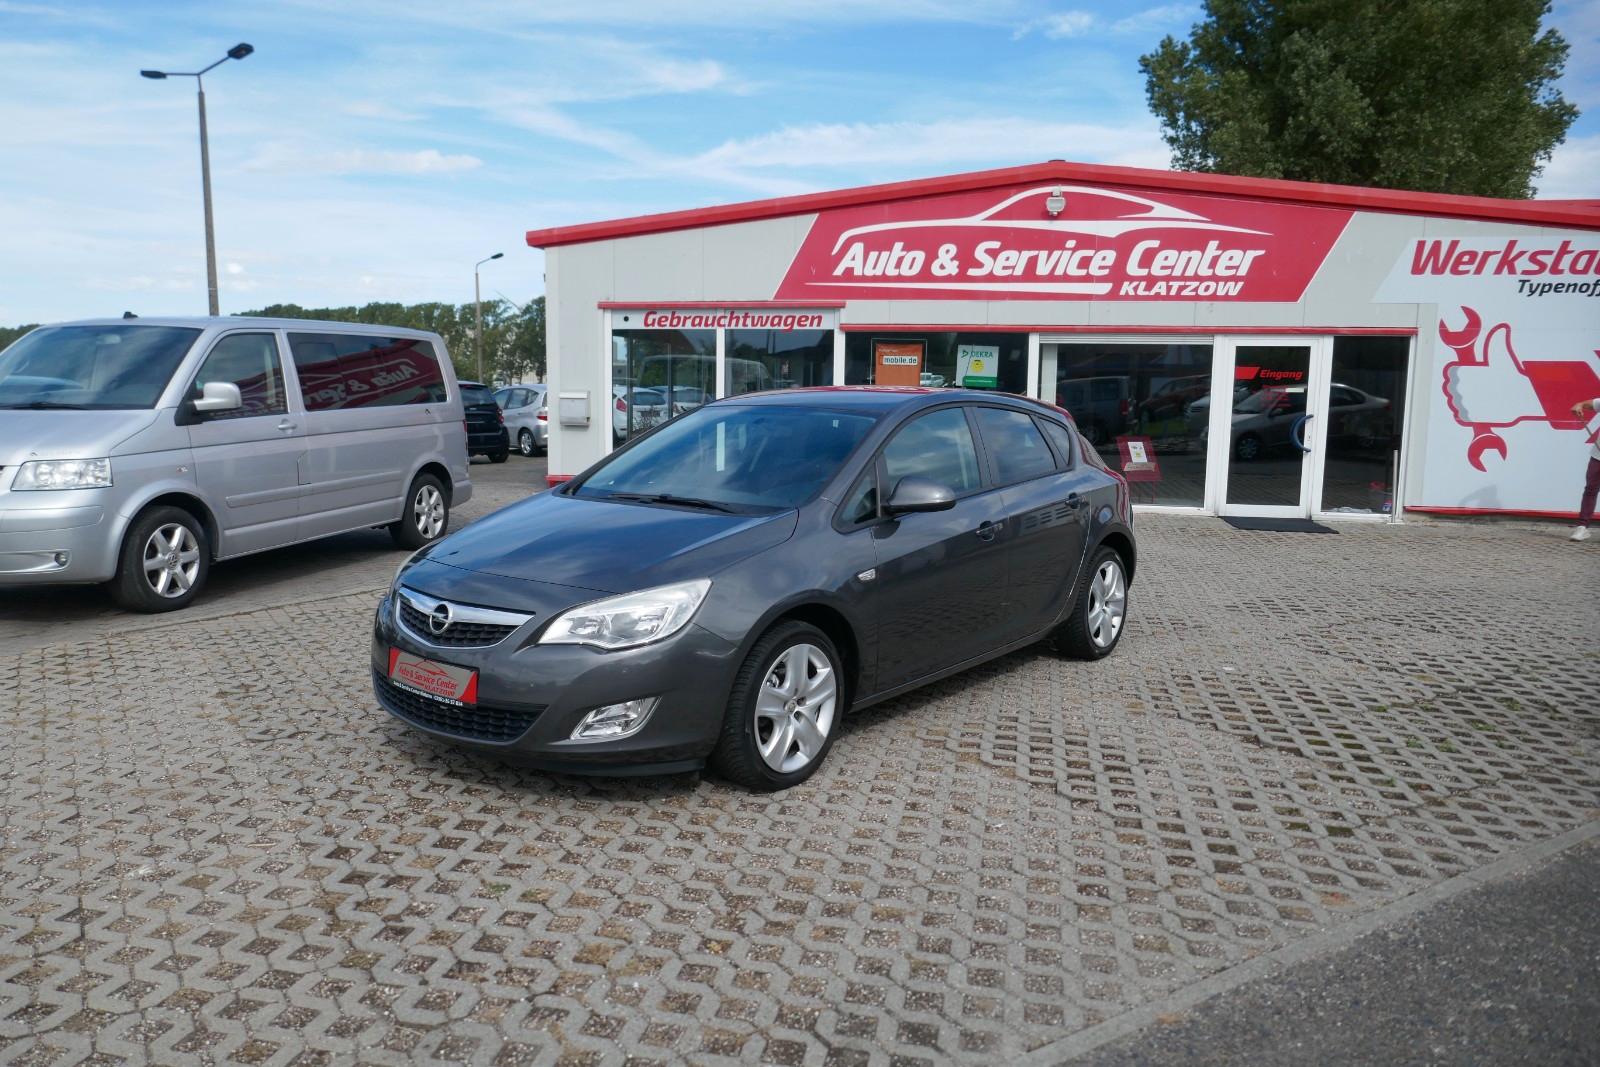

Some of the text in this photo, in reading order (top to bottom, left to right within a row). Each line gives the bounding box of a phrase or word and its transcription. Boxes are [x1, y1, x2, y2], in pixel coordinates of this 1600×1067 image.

[833, 239, 1267, 278] Auto & Service Center
[1411, 239, 1600, 276] Werksta
[1119, 281, 1244, 297] KLATZOW
[643, 310, 823, 332] Gebrauchtwagen
[884, 356, 917, 364] mobile.de
[1260, 369, 1303, 380] Eingang
[415, 671, 435, 685] Service
[436, 677, 458, 690] Center
